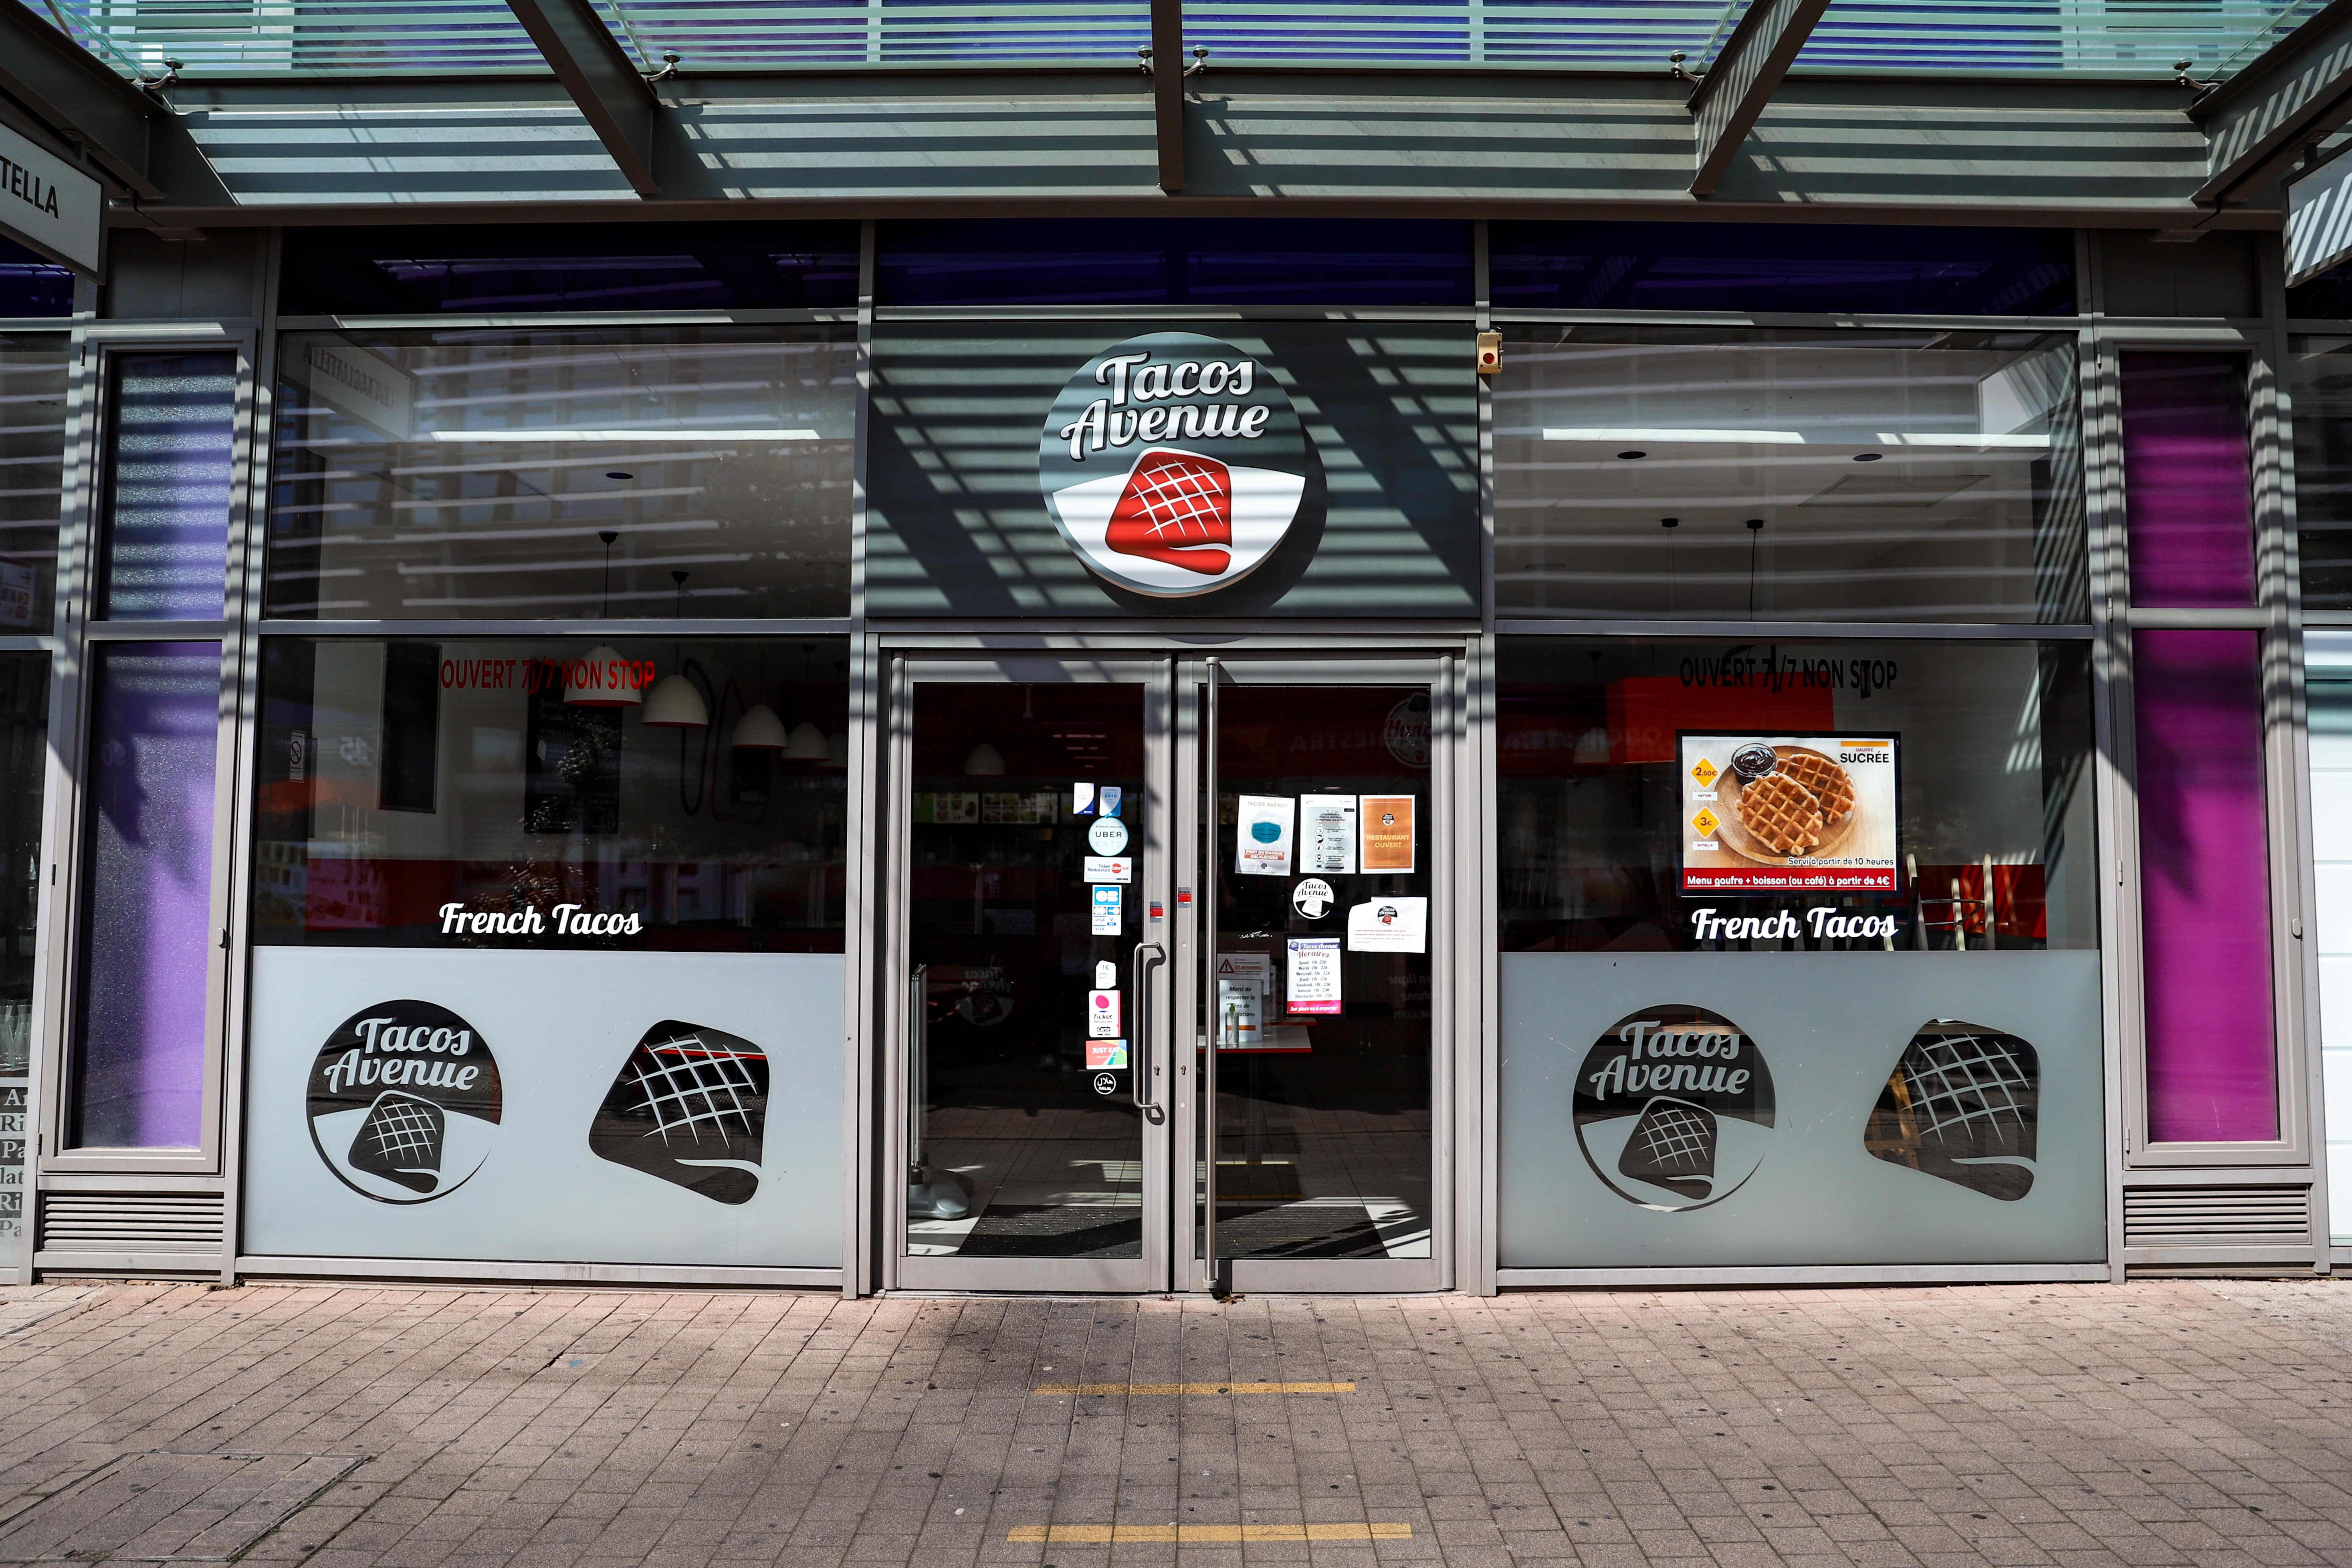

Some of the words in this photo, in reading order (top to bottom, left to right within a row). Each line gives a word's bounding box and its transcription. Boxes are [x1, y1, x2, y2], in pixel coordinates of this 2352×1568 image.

[1095, 351, 1256, 407] Tacos
[1060, 397, 1271, 461] Avenue
[441, 659, 516, 689] OUVERT
[521, 656, 556, 695] 7j/7
[561, 660, 602, 689] NON
[608, 660, 655, 690] STOP
[1680, 657, 1756, 687] OUVERT
[1803, 659, 1843, 688] NON
[1850, 660, 1898, 689] STOP
[1696, 767, 1717, 777] 2,50€
[1840, 751, 1889, 763] SUCRÉE
[1700, 817, 1712, 826] 3€
[1819, 858, 1840, 866] partir
[1297, 888, 1328, 897] Avenue
[1687, 876, 1712, 884] Menu
[1714, 876, 1743, 886] gaufre
[1753, 876, 1786, 884] boisson
[1789, 876, 1802, 886] (ou
[1805, 876, 1826, 886] café)
[1829, 876, 1834, 885] à
[1837, 876, 1861, 886] partir
[1864, 876, 1874, 885] de
[1877, 876, 1890, 885] 4€
[439, 903, 545, 934] French
[552, 904, 642, 934] Tacos
[1691, 908, 1801, 939] French
[1807, 907, 1899, 938] Tacos
[1297, 950, 1329, 959] Horaires
[355, 1017, 470, 1055] Tacos
[1620, 1020, 1739, 1059] Tacos
[323, 1049, 478, 1093] Avenue
[1097, 1077, 1113, 1086] حلال
[1590, 1055, 1750, 1100] Avenue
